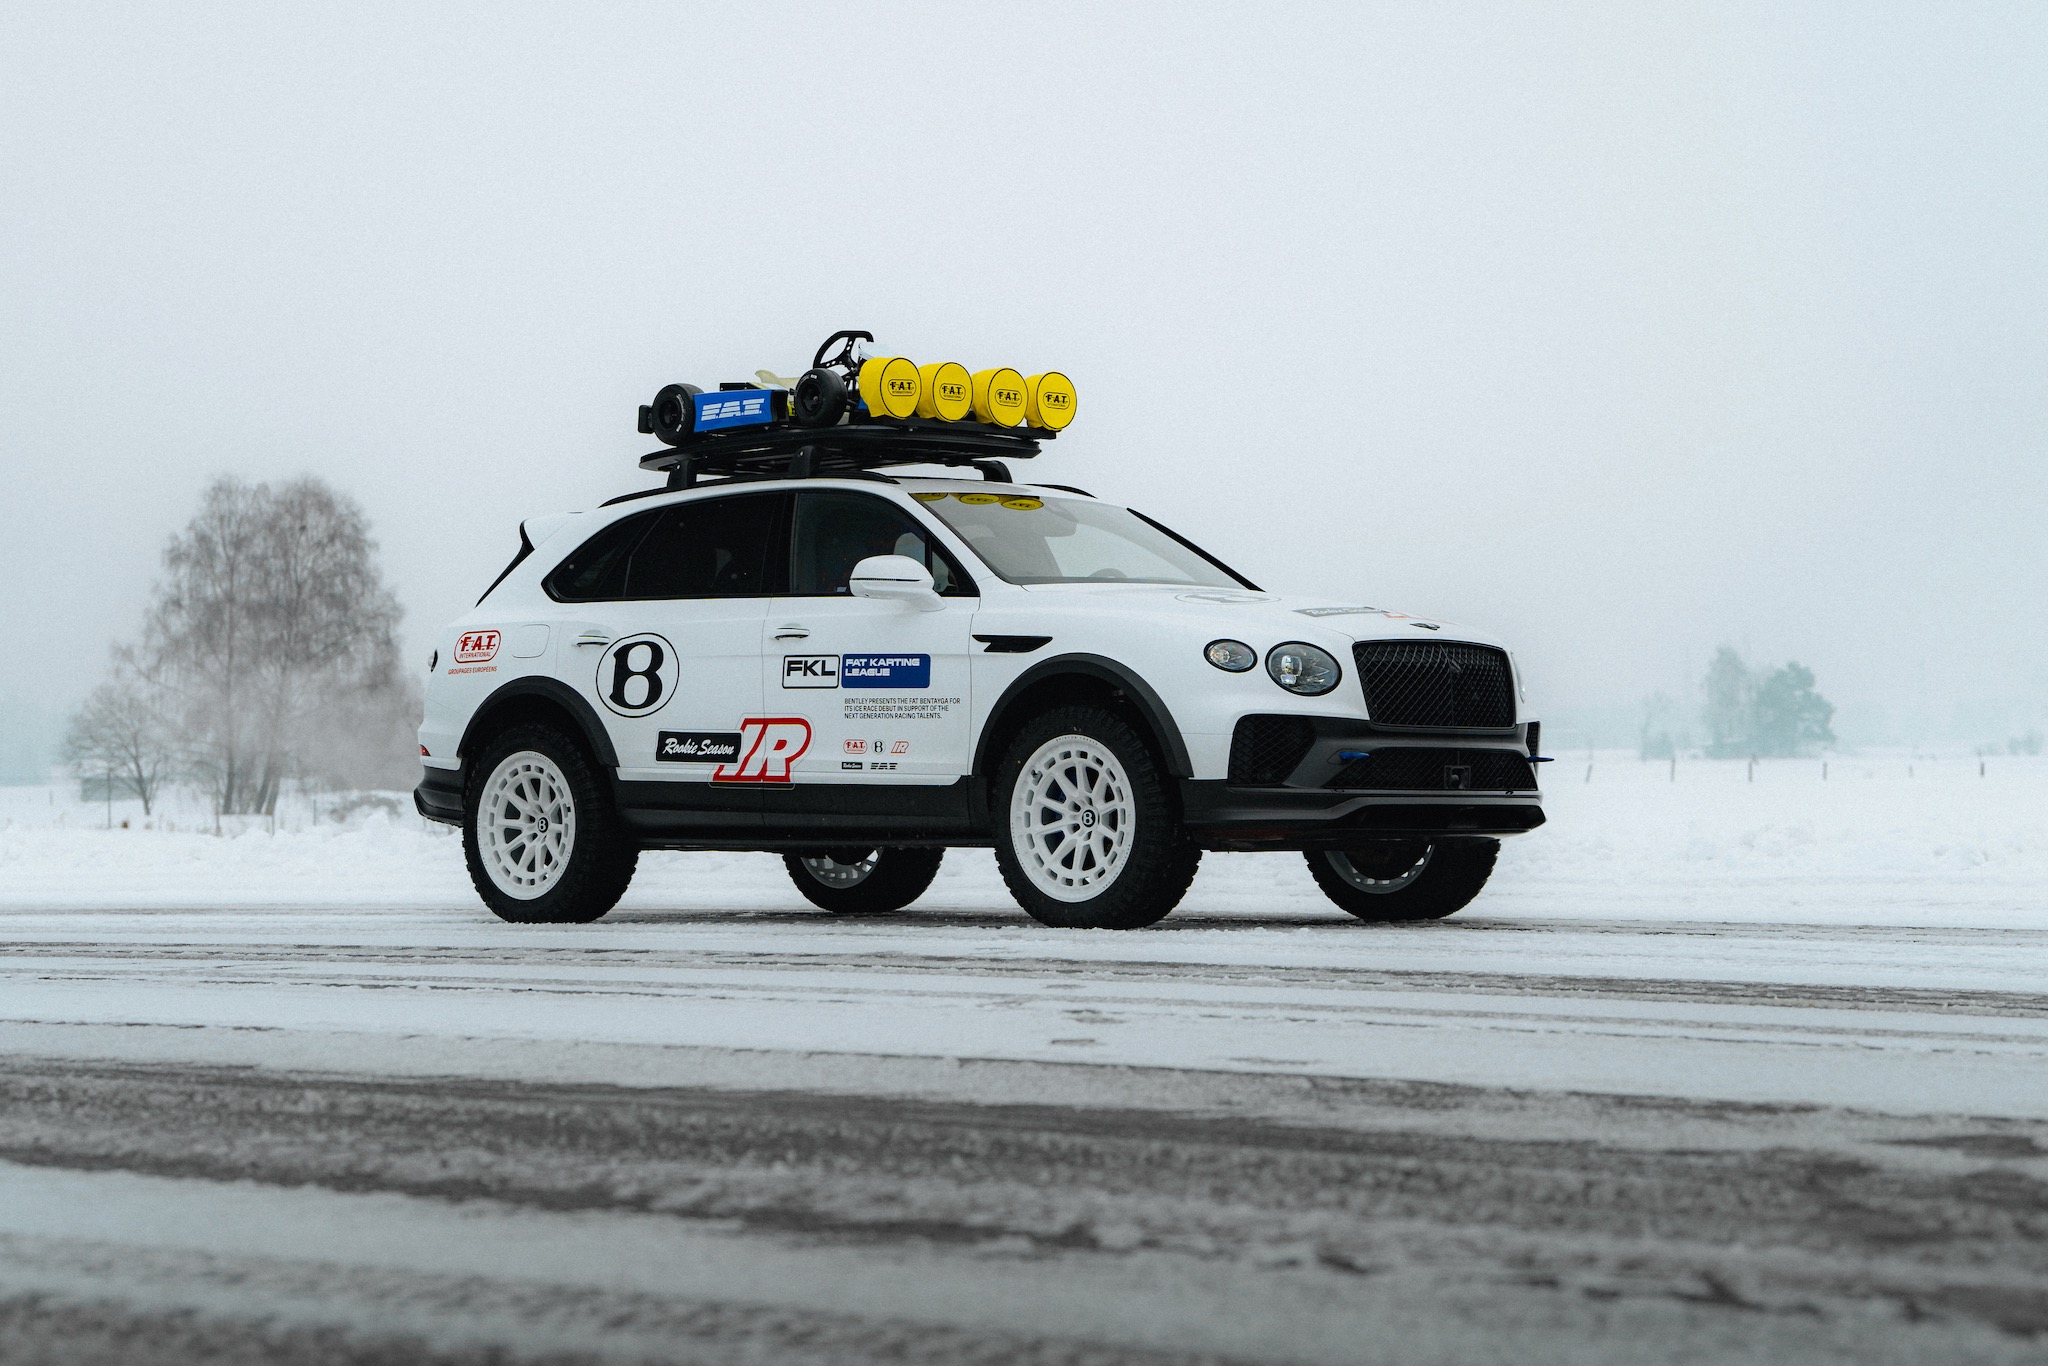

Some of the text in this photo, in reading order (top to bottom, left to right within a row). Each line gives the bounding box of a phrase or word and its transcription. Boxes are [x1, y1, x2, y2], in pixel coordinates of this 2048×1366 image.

[787, 660, 836, 676] FKL
[869, 658, 920, 666] KARTING
[845, 668, 890, 676] LEAGUE
[662, 737, 735, 755] Rookie Season
